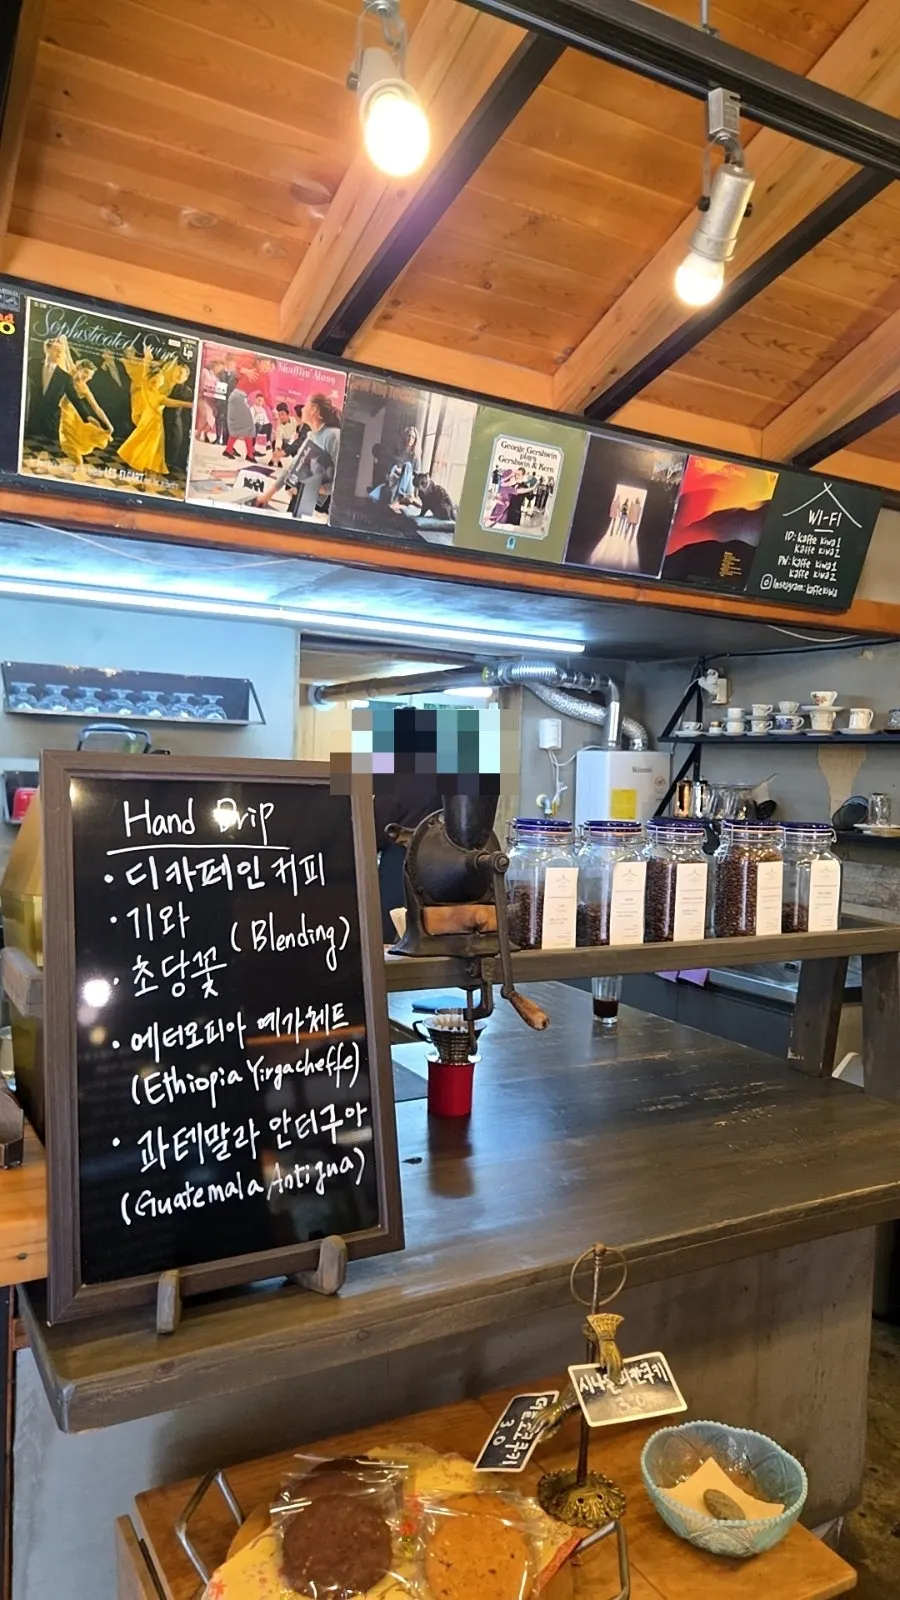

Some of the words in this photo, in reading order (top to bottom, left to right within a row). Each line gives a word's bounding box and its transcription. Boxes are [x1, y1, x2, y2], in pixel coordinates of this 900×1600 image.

[33, 307, 141, 352] Sophisticated
[498, 454, 531, 468] Gershwin
[538, 463, 555, 473] Kern
[500, 440, 525, 453] George
[526, 446, 558, 460] Gershwin
[519, 452, 537, 462] plays
[808, 508, 842, 527] WI-FI
[123, 798, 196, 838] Hand
[125, 852, 266, 893] 디카페인
[271, 851, 326, 897] 커피
[126, 900, 192, 941] 기와
[132, 946, 228, 999] 초당꽃
[131, 1065, 243, 1108] (Ethiopia
[246, 1042, 359, 1091] Yirgacheffe)
[137, 1118, 260, 1172] 과테말라
[121, 1171, 264, 1225] (Guatemala
